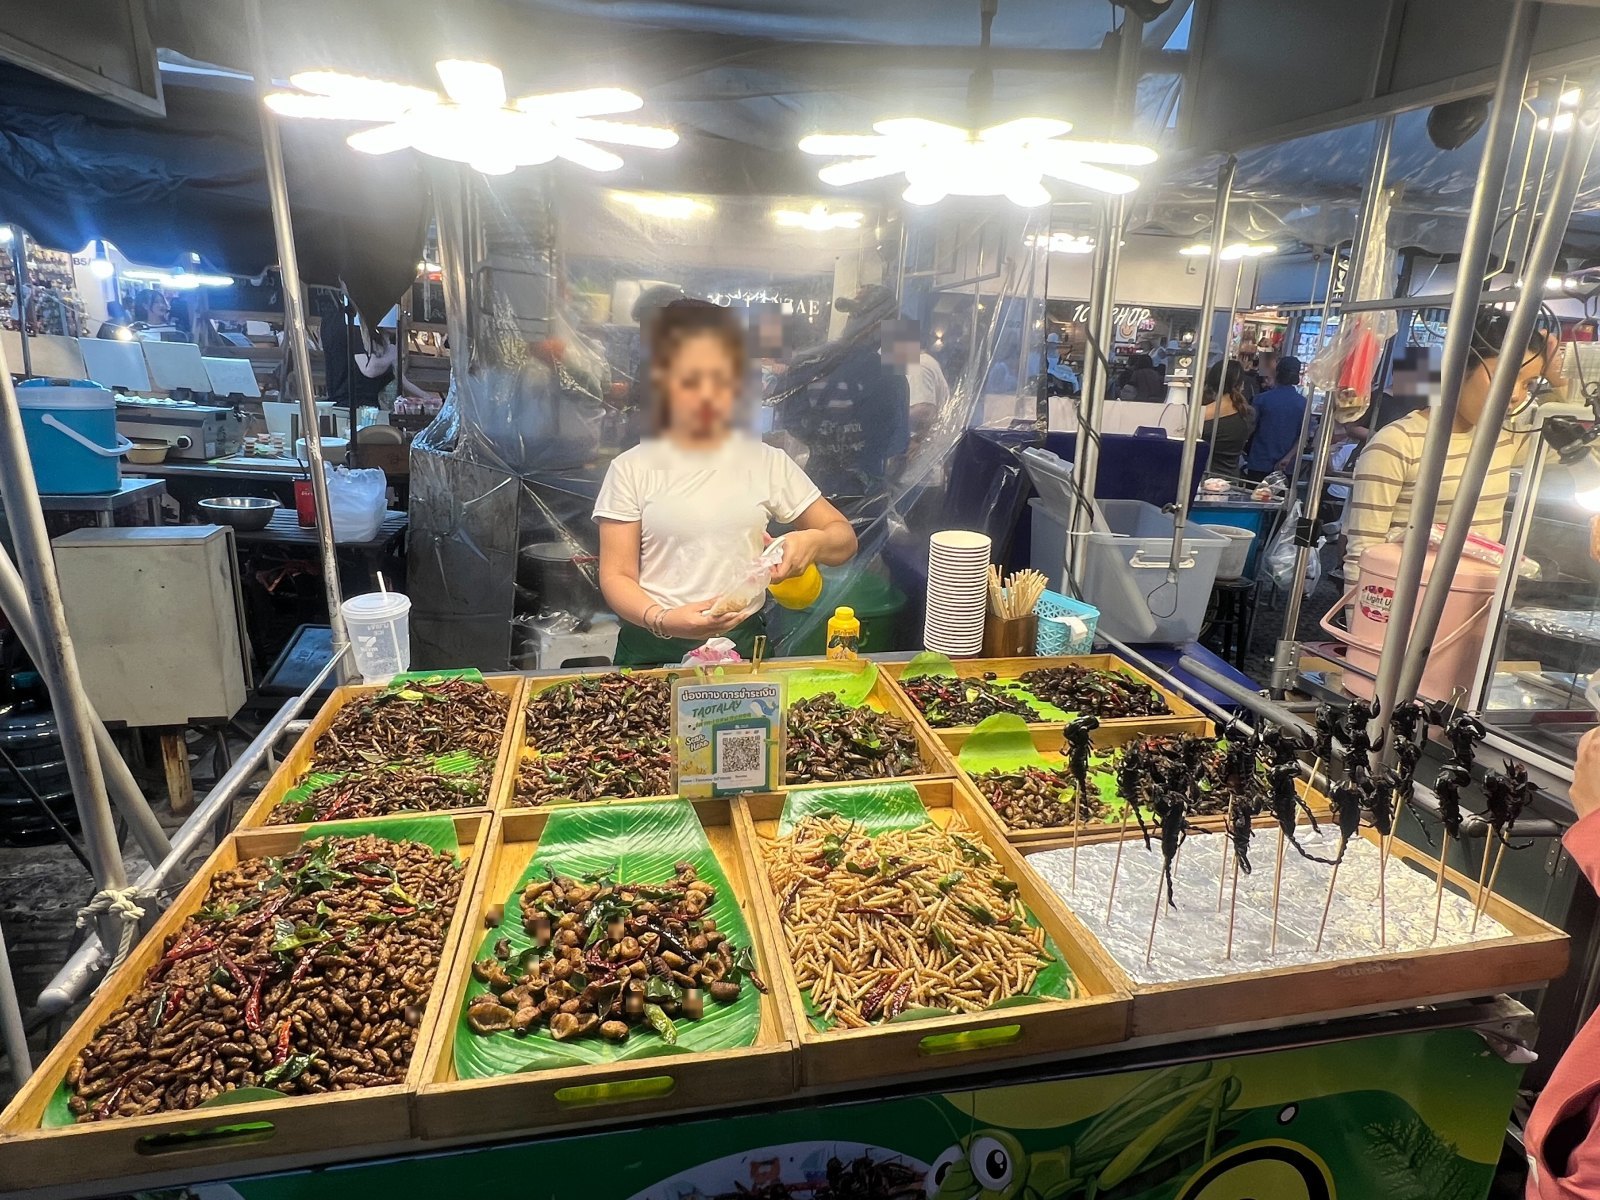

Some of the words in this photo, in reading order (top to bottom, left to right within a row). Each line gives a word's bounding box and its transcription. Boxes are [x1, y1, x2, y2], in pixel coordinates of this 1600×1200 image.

[1366, 594, 1383, 604] Light
[682, 690, 720, 701] ช่องทาง
[721, 688, 776, 700] การชำระเงิน
[692, 700, 742, 718] TAOTALAY
[685, 734, 705, 746] Scan
[690, 739, 709, 752] Here
